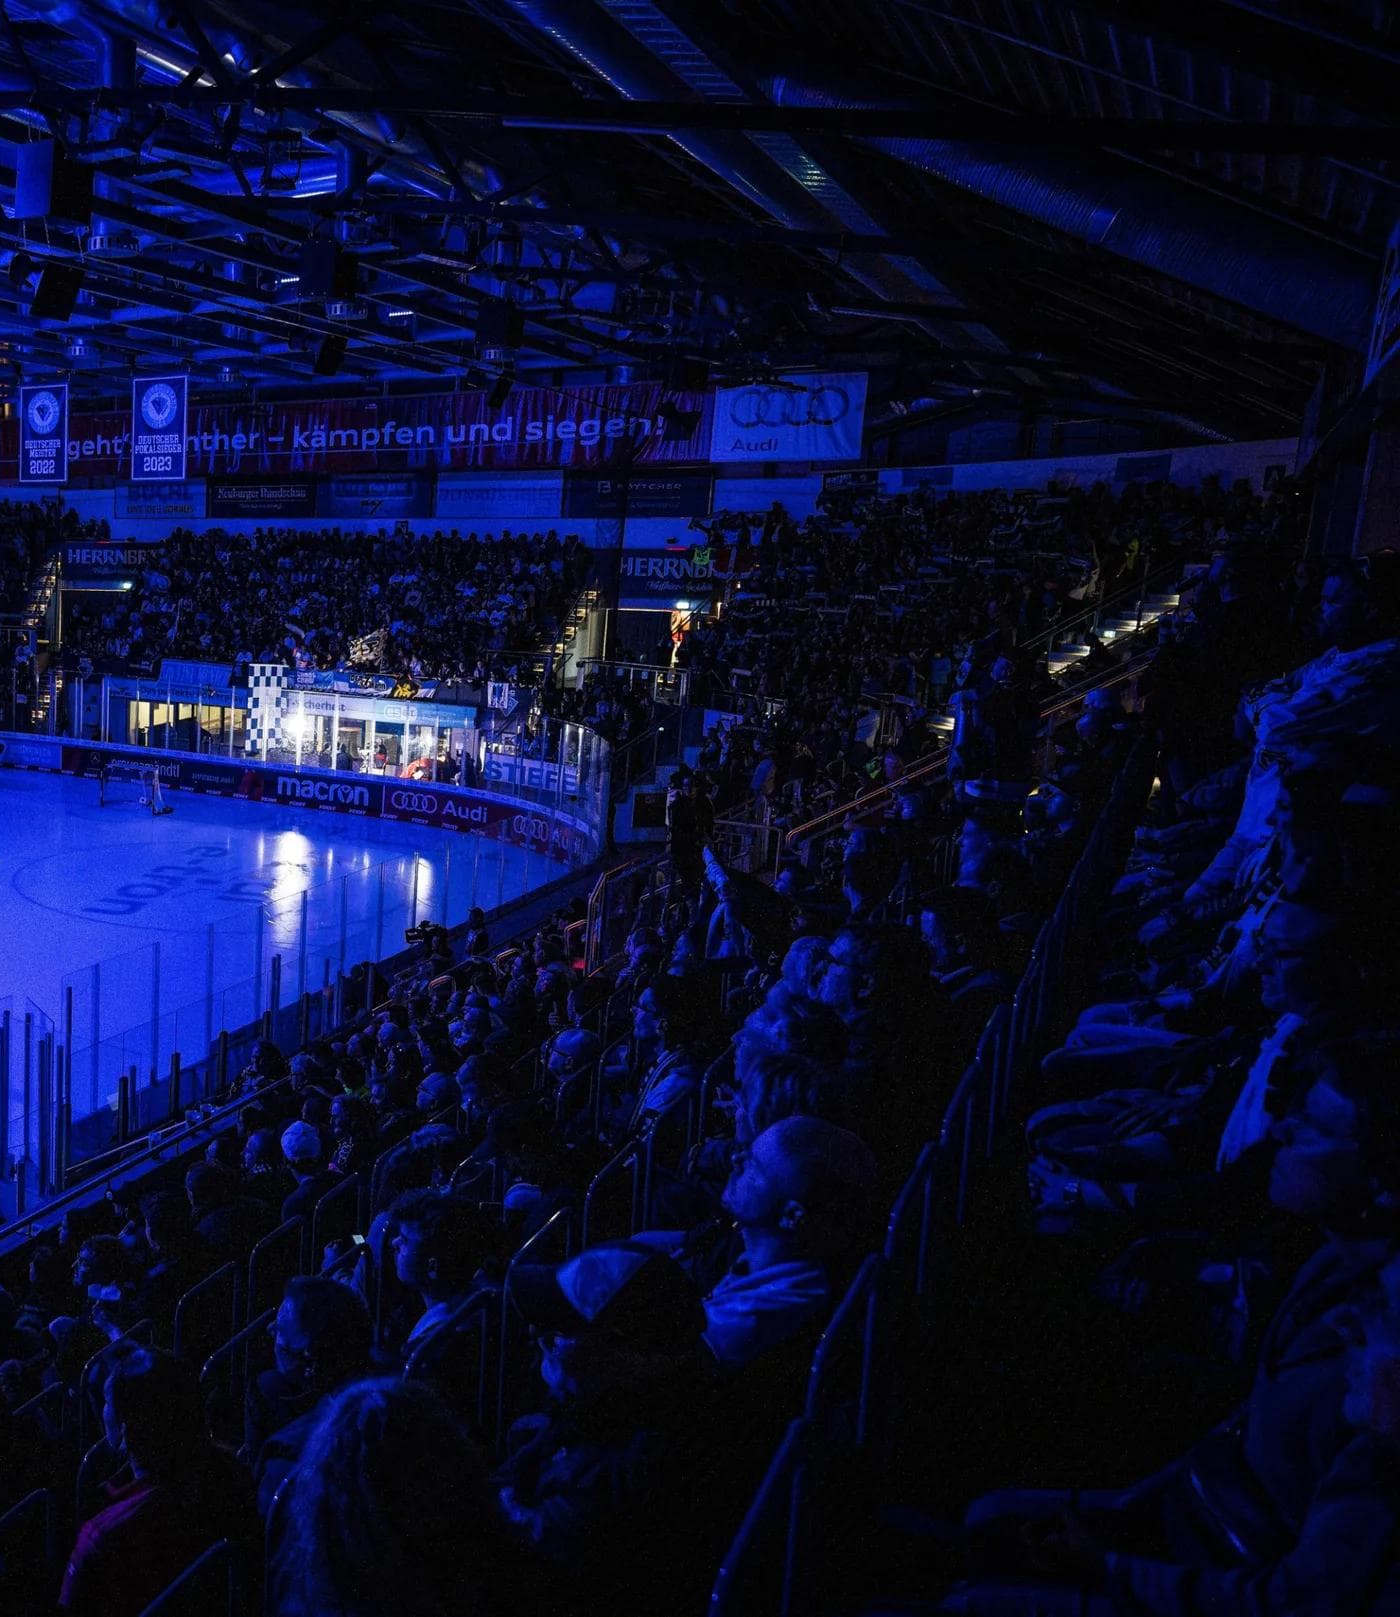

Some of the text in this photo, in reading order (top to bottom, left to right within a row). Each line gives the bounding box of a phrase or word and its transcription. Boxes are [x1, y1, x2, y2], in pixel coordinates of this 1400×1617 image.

[187, 425, 259, 452] nther
[293, 419, 435, 459] kämpfen
[447, 416, 513, 445] und
[525, 412, 664, 449] siegen!
[731, 438, 778, 452] Audi
[30, 460, 55, 474] 2022
[143, 456, 172, 471] 2023
[67, 548, 148, 565] HERRNBR
[277, 775, 369, 806] macron
[441, 799, 488, 824] Audi
